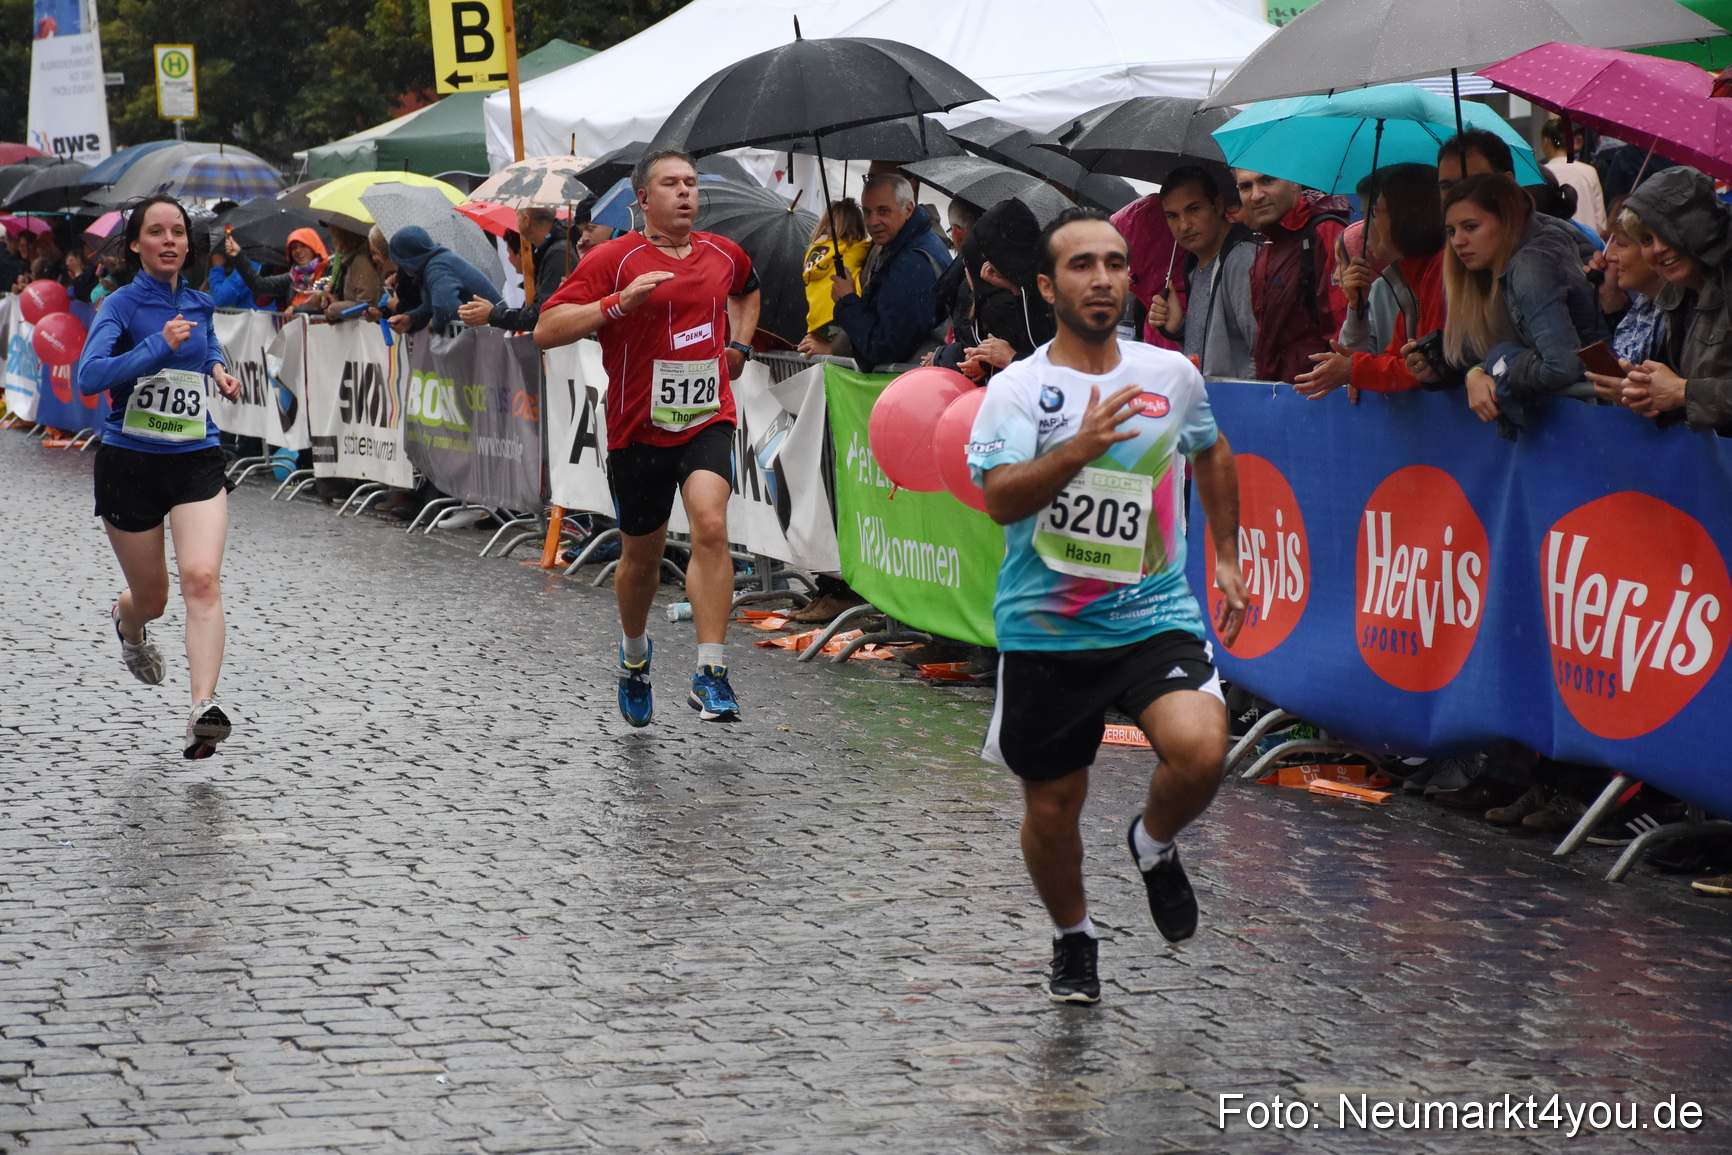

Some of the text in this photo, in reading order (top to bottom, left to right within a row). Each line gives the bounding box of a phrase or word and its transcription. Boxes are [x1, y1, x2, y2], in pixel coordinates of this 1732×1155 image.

[452, 1, 495, 63] B
[168, 57, 182, 72] H
[685, 330, 703, 342] DEHN
[137, 384, 200, 417] 5183
[660, 377, 716, 404] 5128
[148, 417, 183, 432] Sophia
[1039, 414, 1069, 428] PARL
[969, 440, 1005, 454] OCK
[1092, 473, 1143, 492] BOCK
[1050, 491, 1141, 541] 5203
[857, 512, 960, 588] Willkommen
[1066, 543, 1111, 565] Hasan
[1213, 509, 1304, 620] ervis
[1362, 510, 1481, 648] Hervis
[1214, 600, 1260, 628] STS
[1548, 530, 1721, 692] Hervis
[1362, 625, 1418, 656] SPORTS
[1558, 659, 1616, 699] SPORTS
